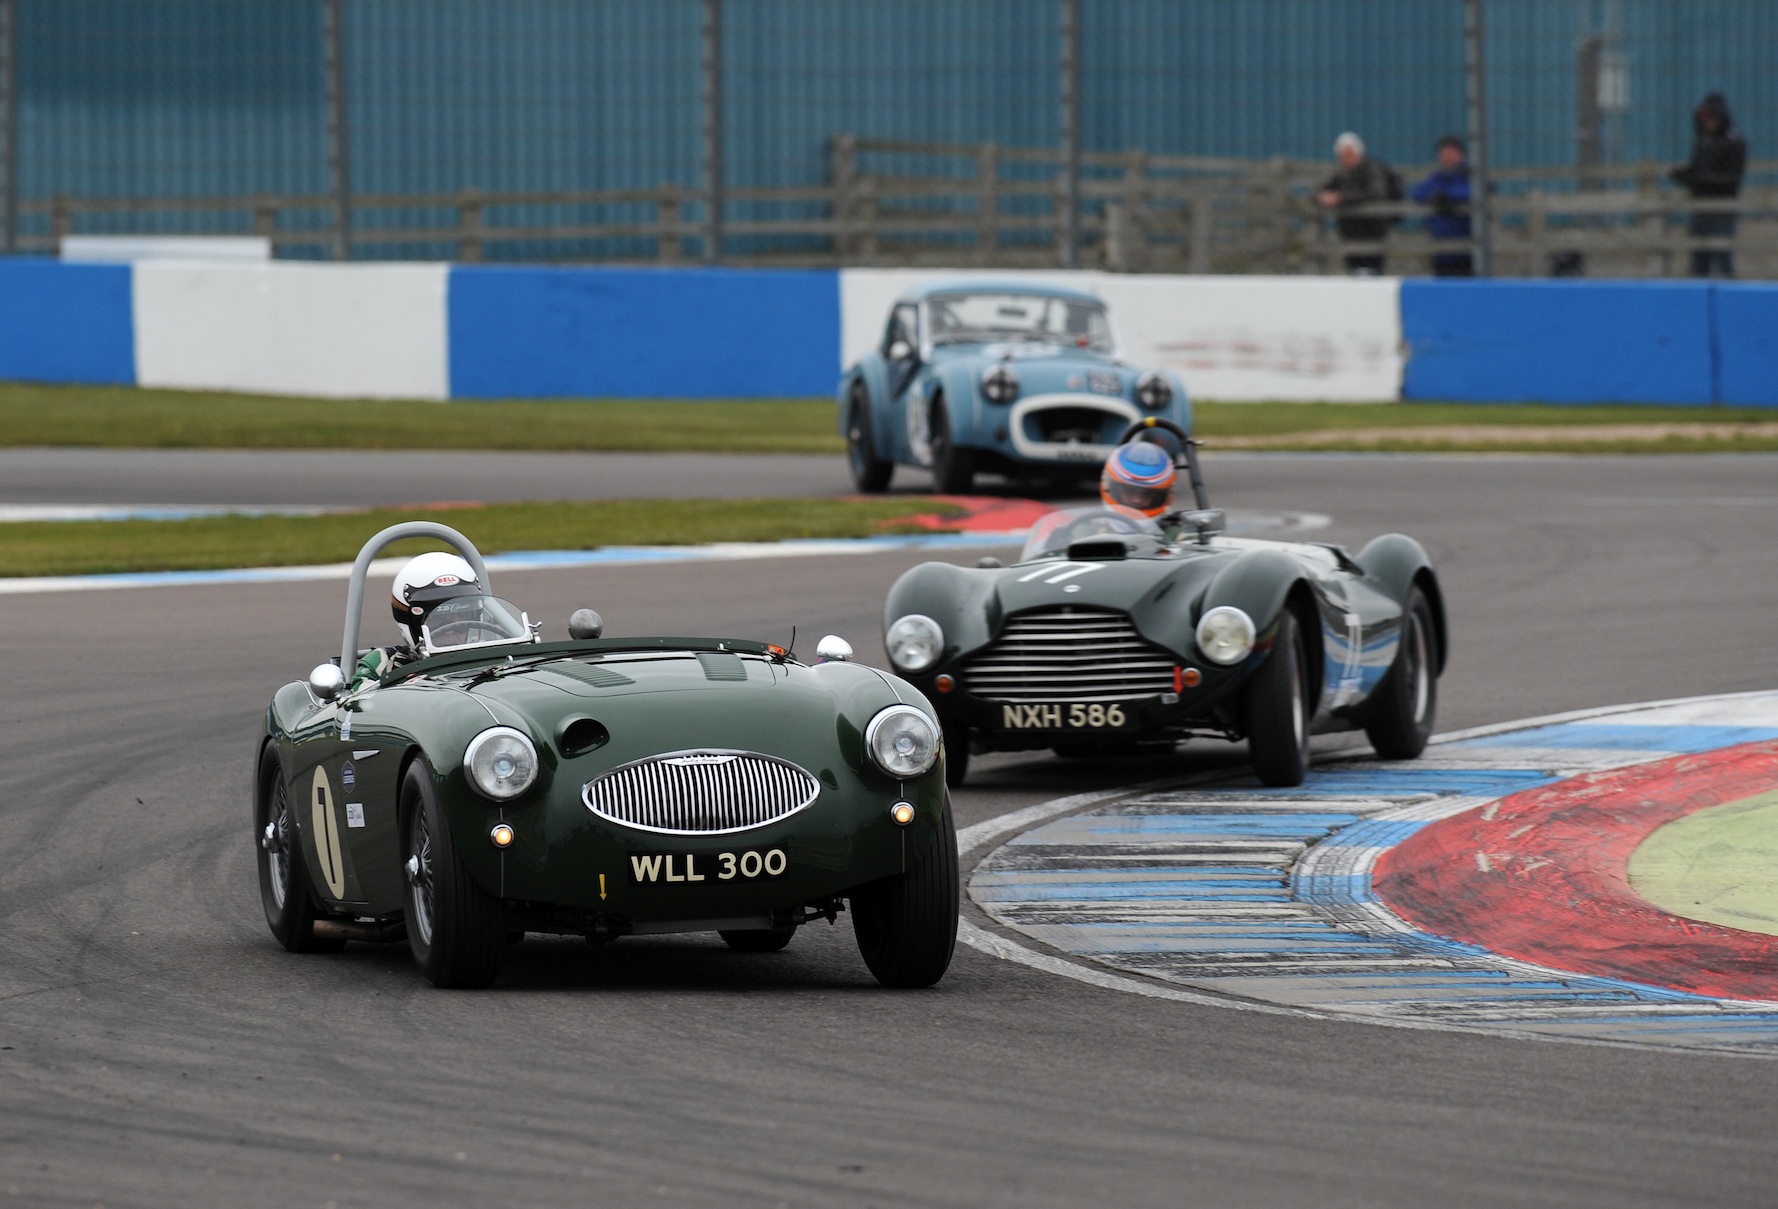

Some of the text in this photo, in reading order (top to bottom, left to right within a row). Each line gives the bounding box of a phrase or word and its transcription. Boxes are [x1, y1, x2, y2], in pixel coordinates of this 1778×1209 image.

[437, 576, 457, 584] BELL
[1003, 703, 1126, 728] NXH 586
[631, 849, 787, 882] WLL 300
